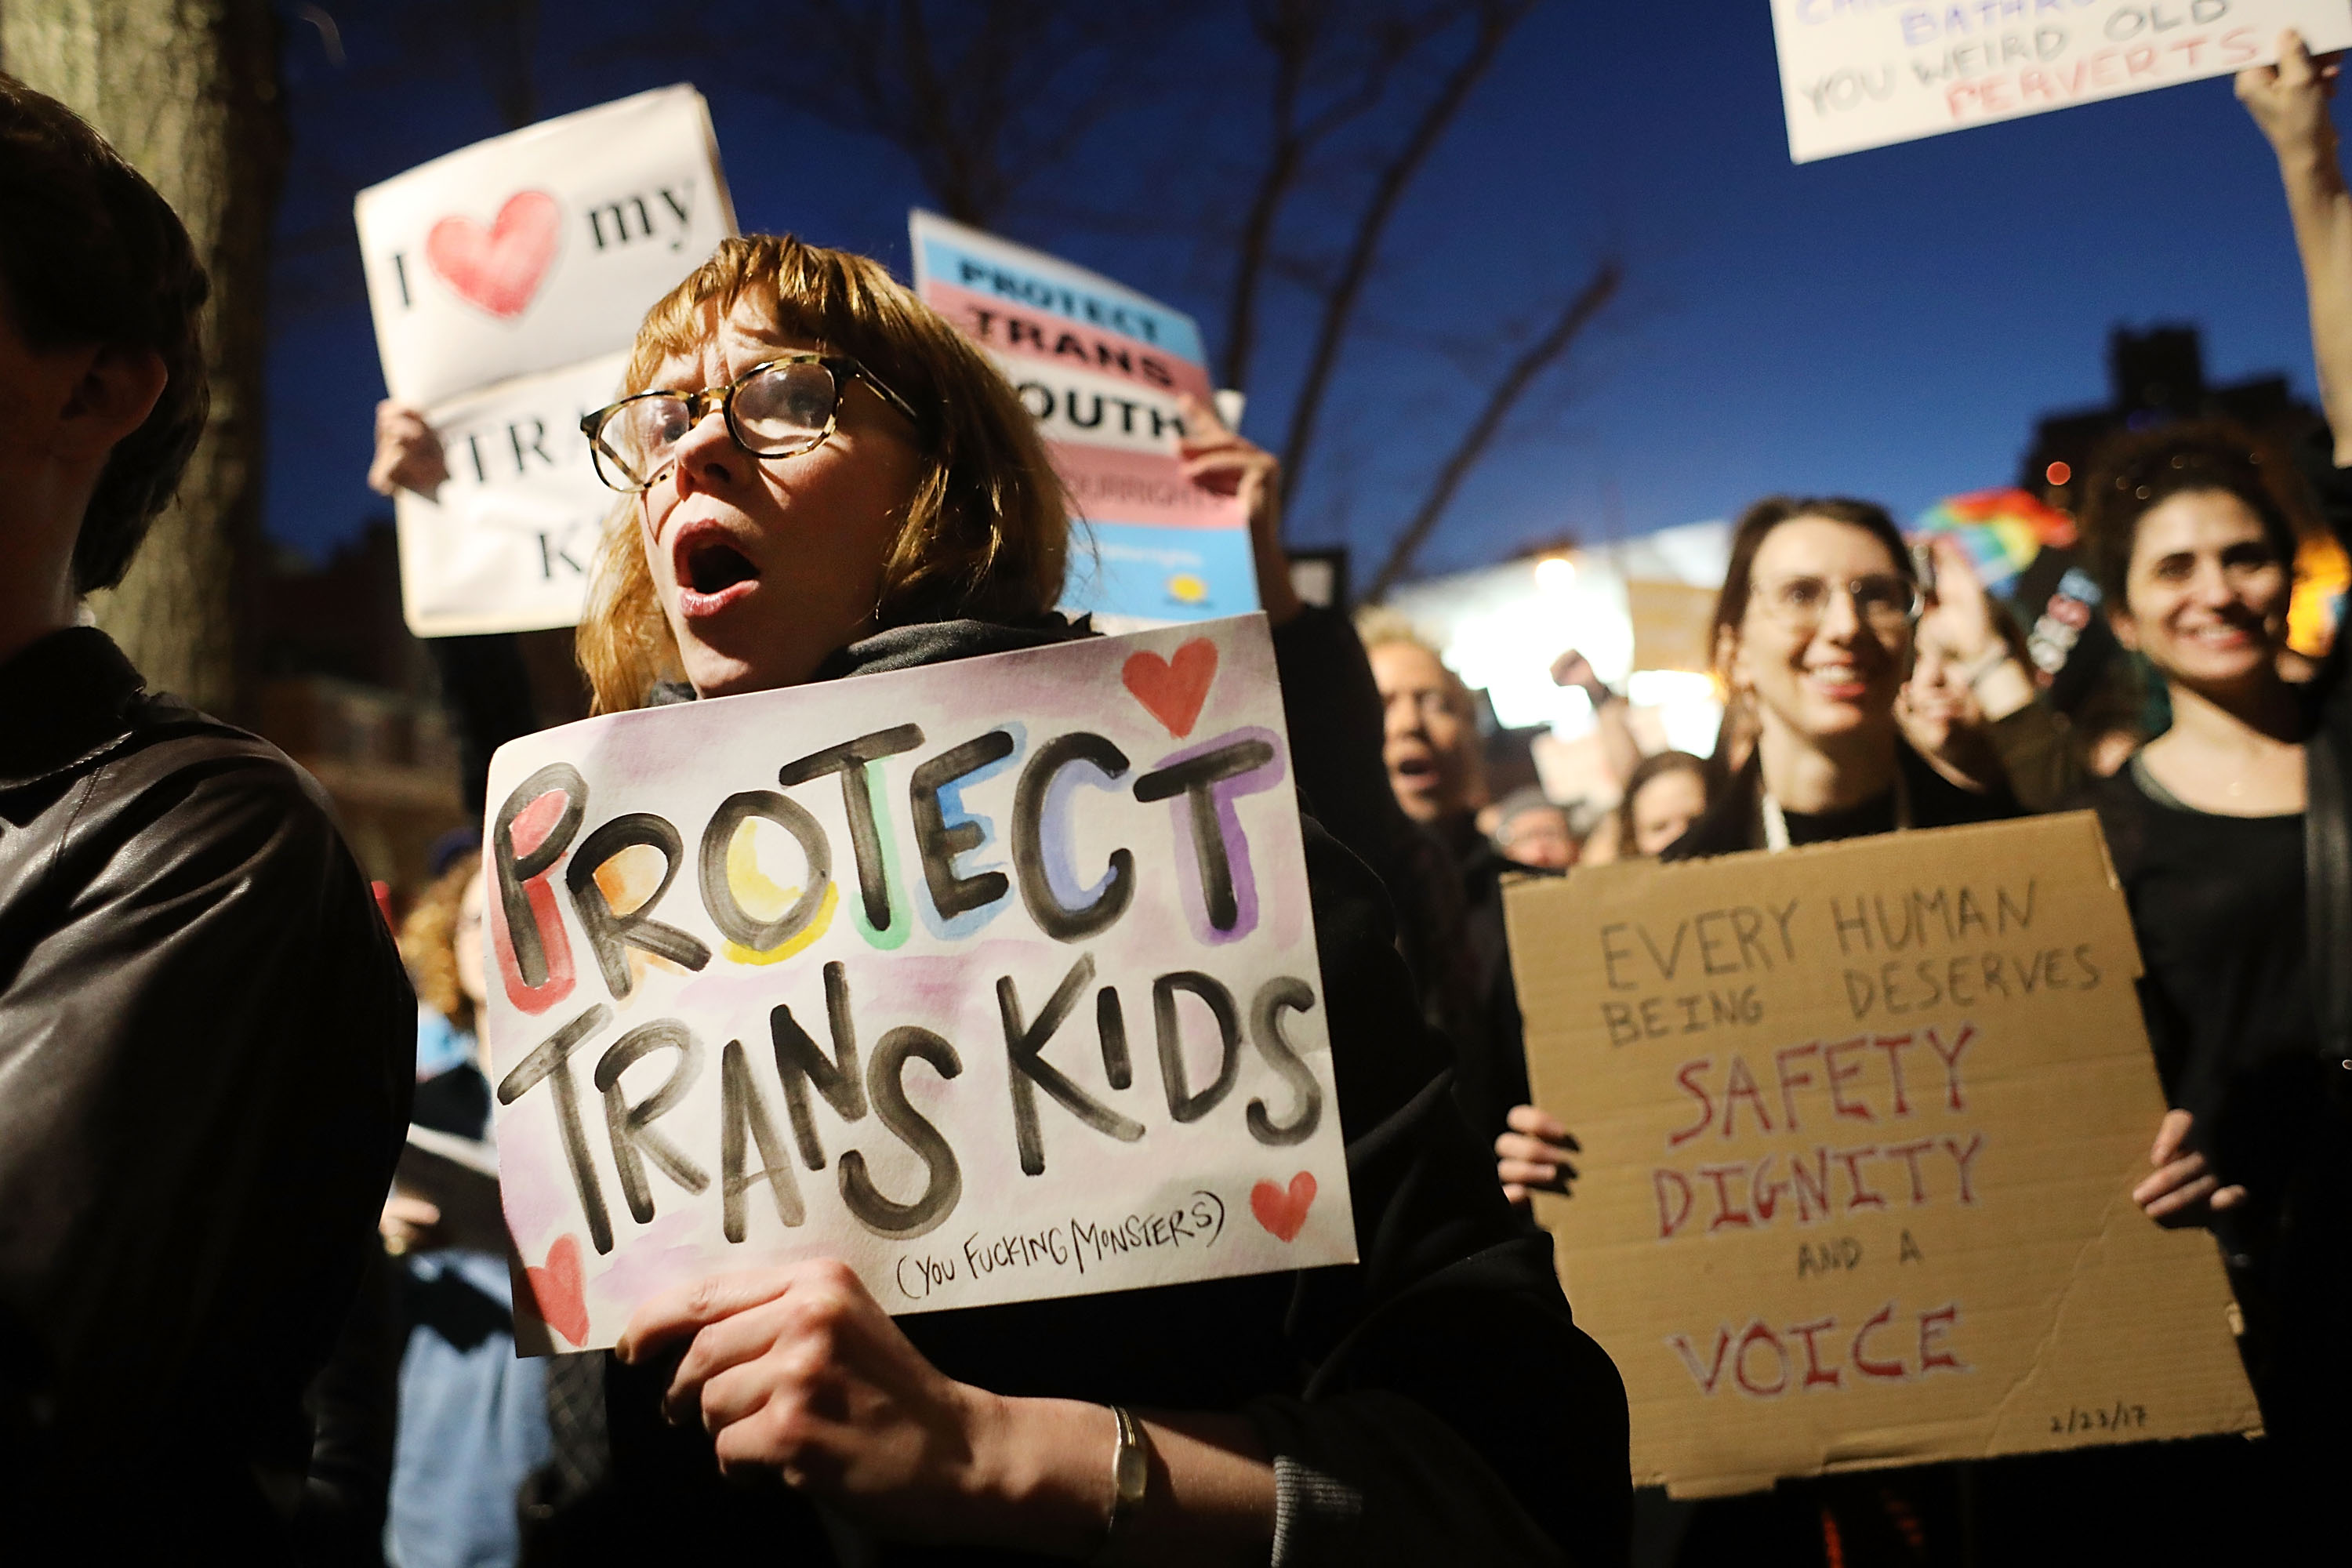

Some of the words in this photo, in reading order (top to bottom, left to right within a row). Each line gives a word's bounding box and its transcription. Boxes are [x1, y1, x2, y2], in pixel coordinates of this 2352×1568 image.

[1800, 64, 1896, 117] YOU
[1910, 24, 2067, 87] WEIRD
[2104, 0, 2229, 42] OLD
[1945, 25, 2259, 119] PERVERTS
[388, 251, 412, 309] I
[583, 178, 697, 251] my
[957, 260, 1160, 342] PROTECT
[967, 305, 1174, 387] TRANS
[1018, 381, 1186, 437] OUTH
[494, 723, 1275, 1001] PROTECT
[1599, 897, 1799, 993] EVERY
[1831, 879, 2038, 957] HUMAN
[1601, 985, 1764, 1048] BEING
[1843, 942, 2103, 1022] DESERVES
[497, 961, 964, 1255] TRANS
[996, 952, 1323, 1177] KIDS
[1666, 1022, 1976, 1148] SAFETY
[1652, 1134, 1984, 1240] DIGNITY
[964, 1232, 1067, 1279] FUCKING
[1797, 1241, 1862, 1279] AND
[1899, 1229, 1922, 1266] A
[1668, 1303, 1969, 1398] VOICE
